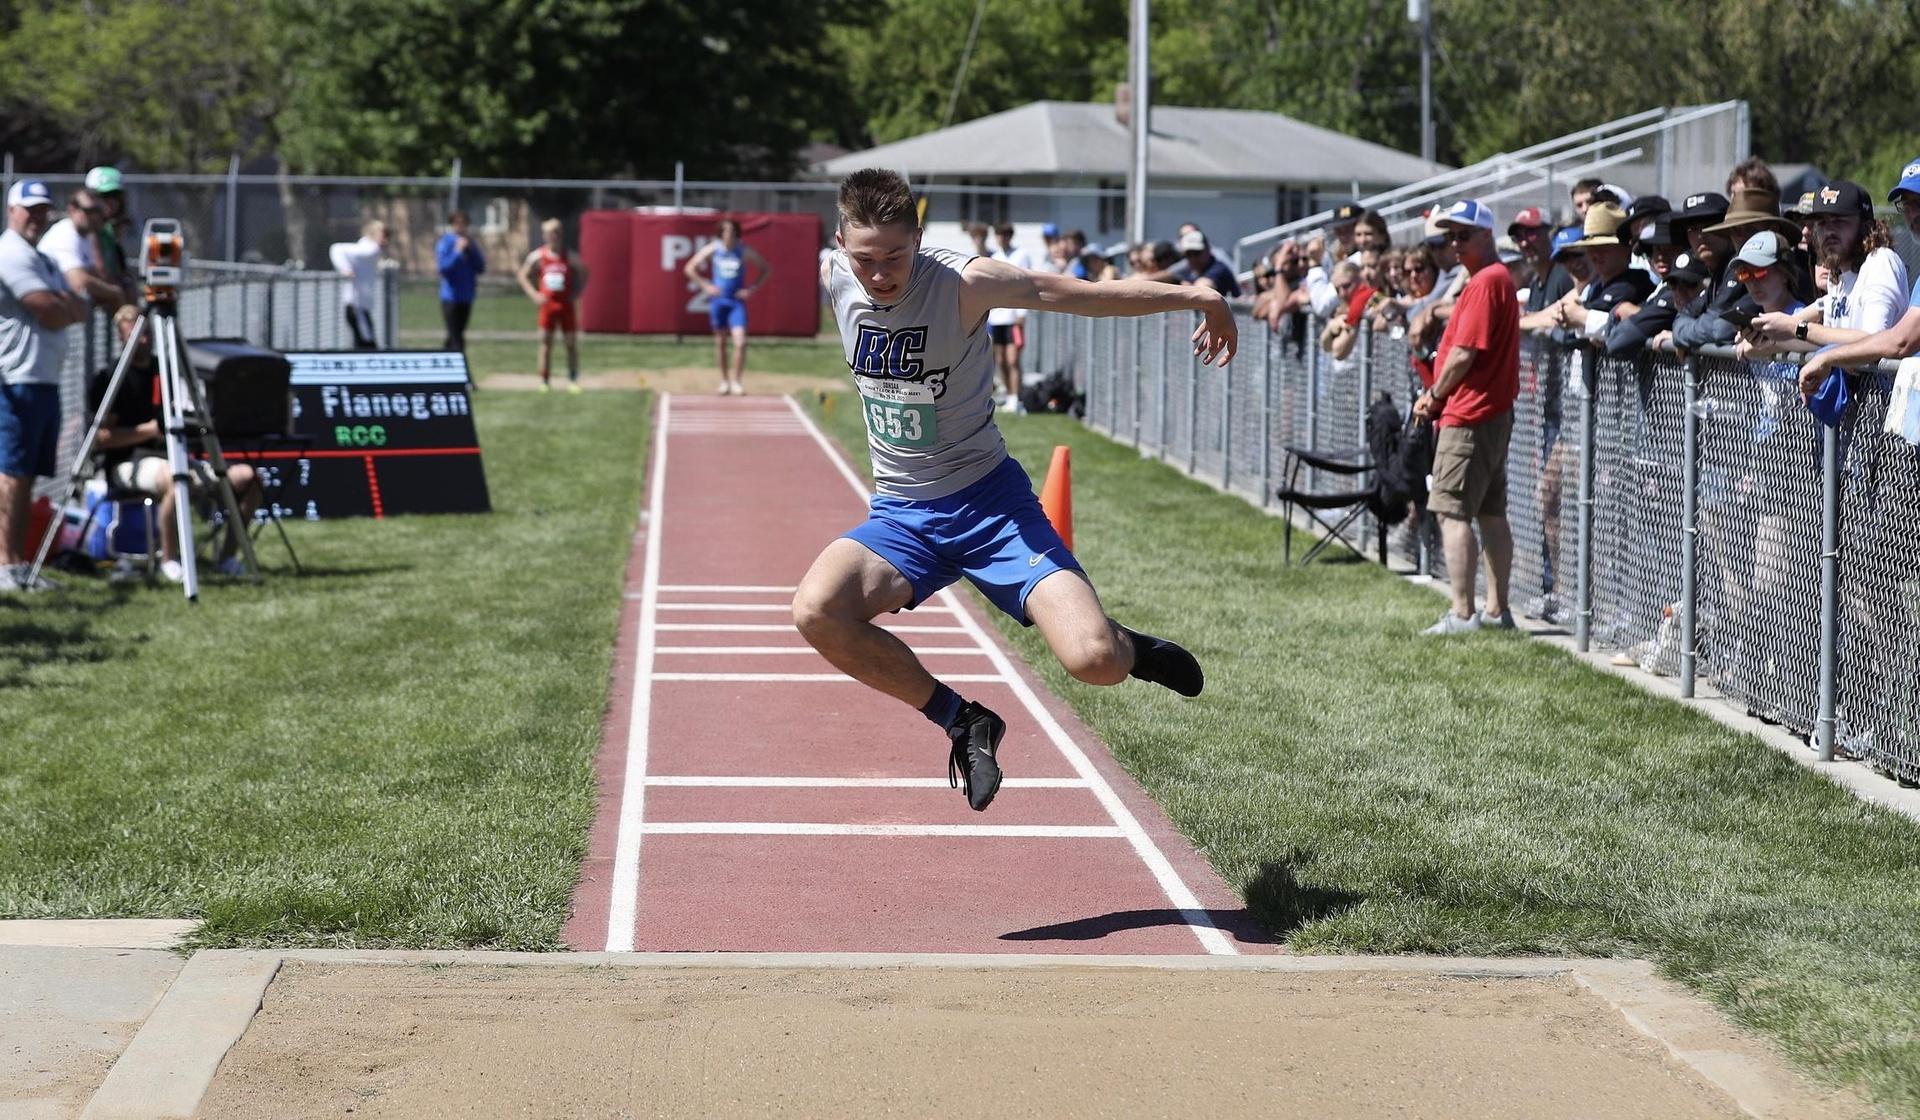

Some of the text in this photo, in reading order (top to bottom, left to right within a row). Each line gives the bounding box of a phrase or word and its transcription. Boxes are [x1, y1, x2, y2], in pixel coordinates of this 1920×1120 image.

[852, 323, 929, 380] RC
[334, 425, 387, 446] RCC
[870, 403, 922, 440] 653
